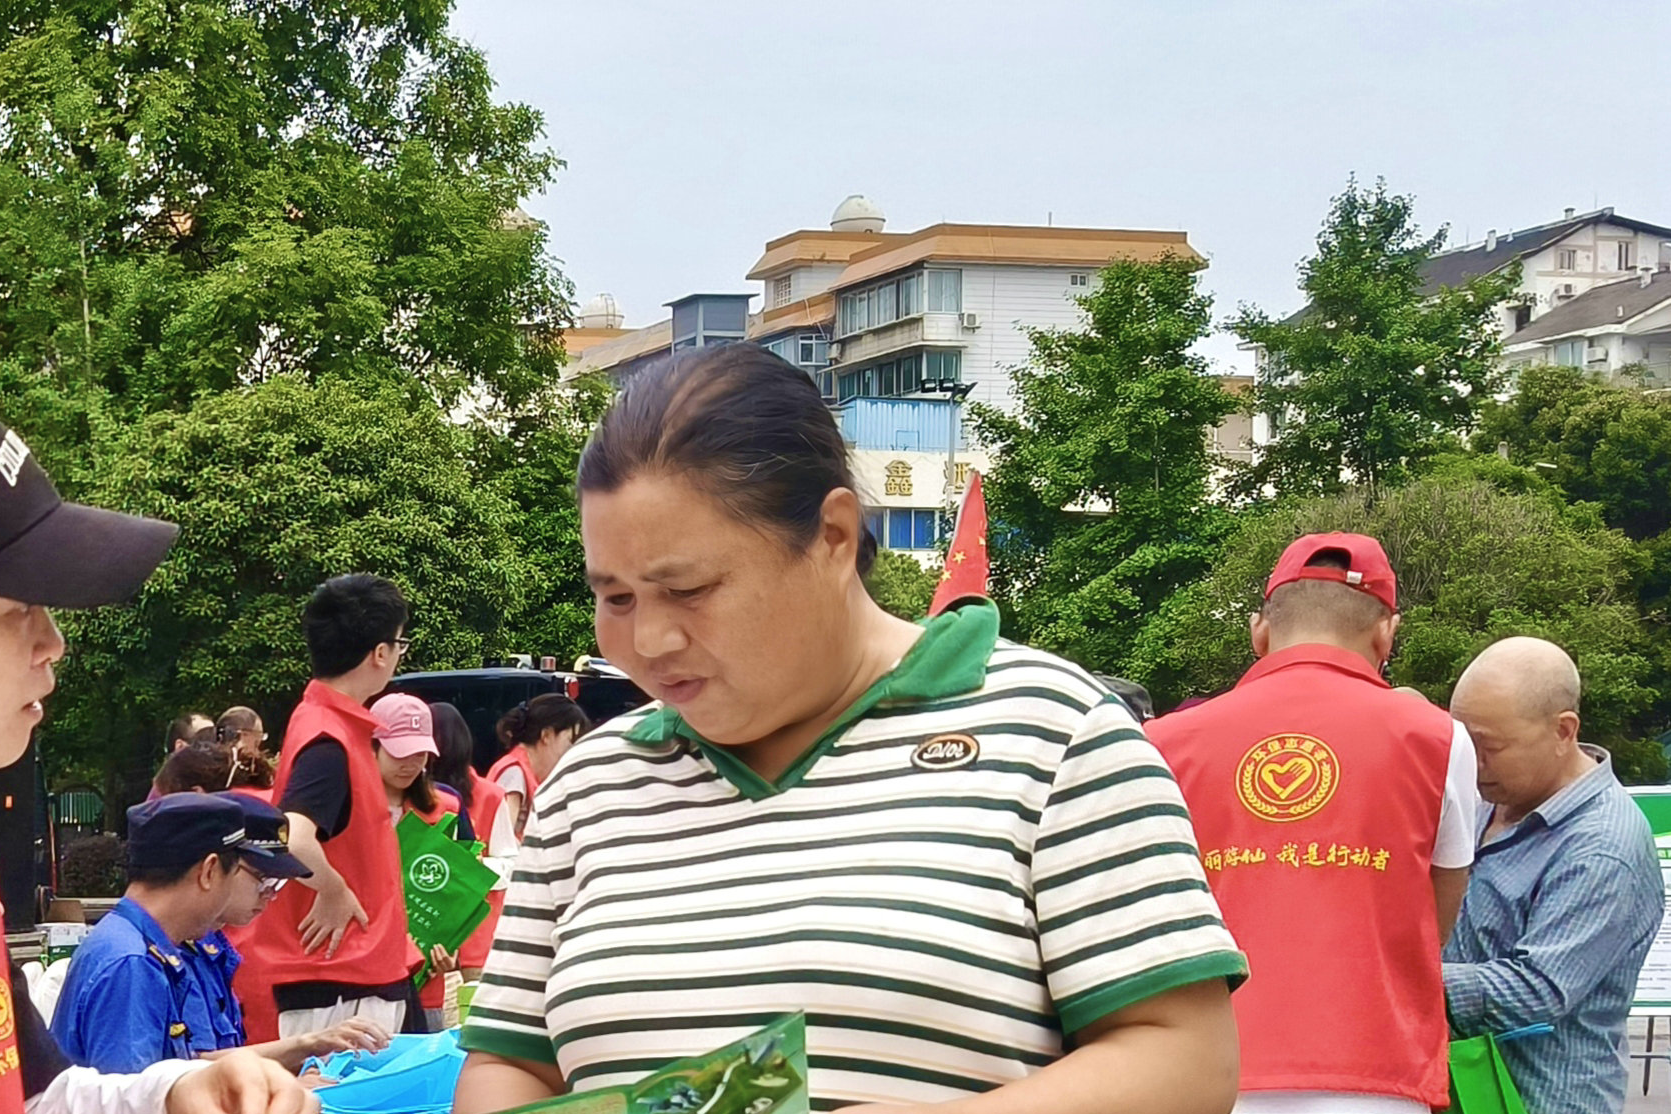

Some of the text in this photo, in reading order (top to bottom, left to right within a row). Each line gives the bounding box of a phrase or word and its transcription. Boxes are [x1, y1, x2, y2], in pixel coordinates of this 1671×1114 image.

[1276, 842, 1390, 871] 我是行动者
